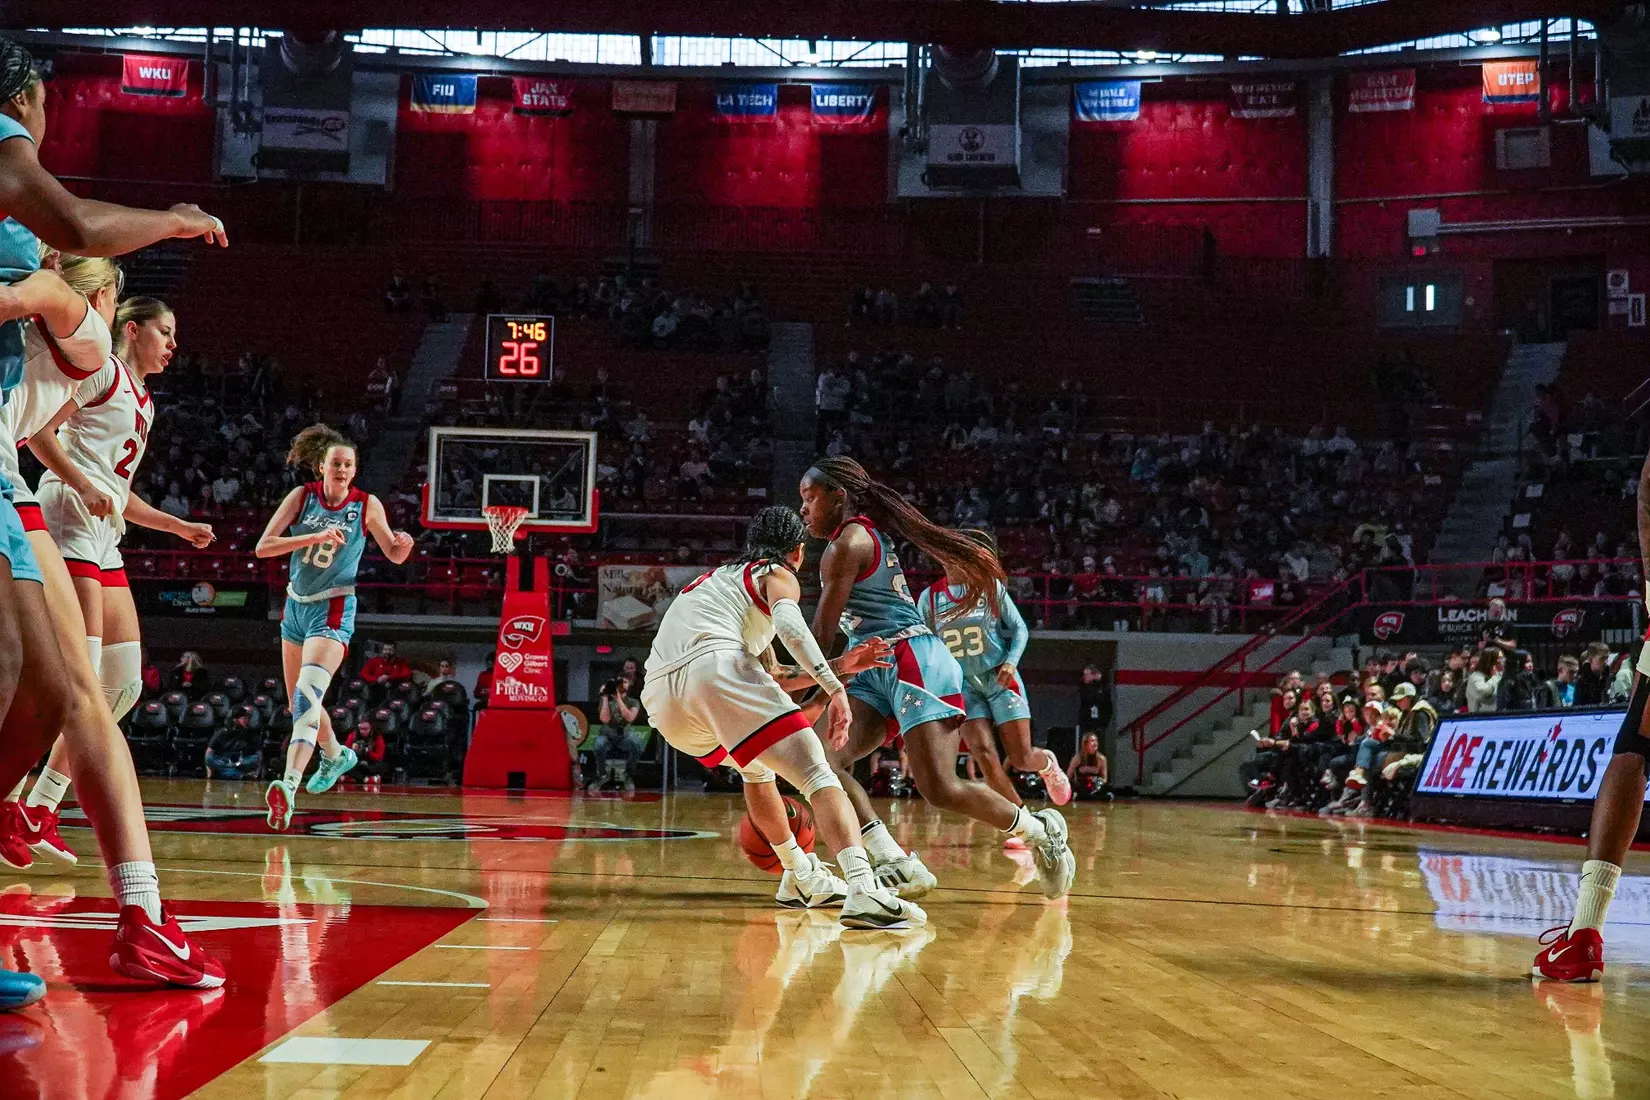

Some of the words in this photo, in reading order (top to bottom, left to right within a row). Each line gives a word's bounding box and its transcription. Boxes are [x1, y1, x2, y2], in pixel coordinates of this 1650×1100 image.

[139, 66, 171, 79] WKU
[1498, 72, 1534, 86] UTEP
[432, 84, 455, 96] FIU
[531, 82, 558, 94] JAX
[522, 94, 568, 107] STATE
[716, 94, 734, 106] LA
[738, 94, 773, 106] TECH
[815, 94, 874, 107] LIBERTY
[507, 322, 546, 341] 7:46
[500, 341, 538, 375] 26
[114, 438, 138, 480] 2
[302, 540, 337, 569] 18
[1438, 606, 1518, 623] LEACHAN
[513, 622, 535, 632] WKU
[943, 626, 984, 659] 23
[1424, 726, 1485, 790] ACE
